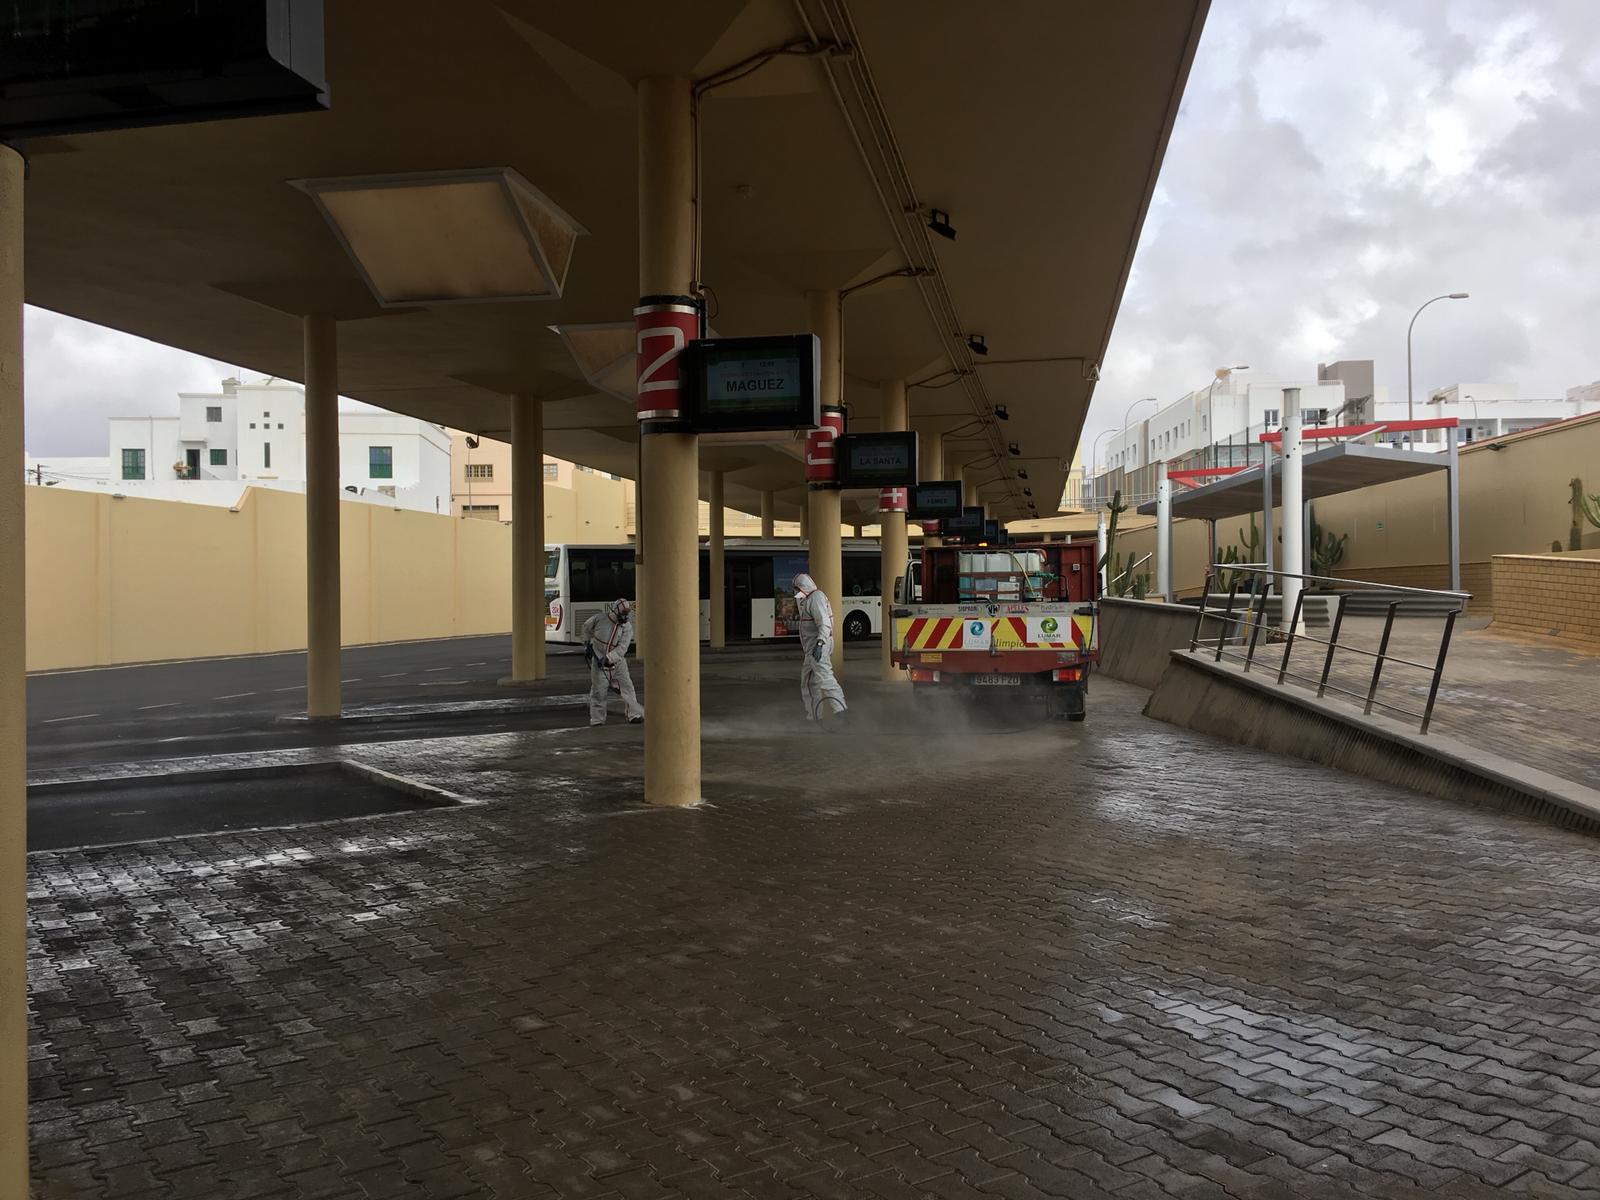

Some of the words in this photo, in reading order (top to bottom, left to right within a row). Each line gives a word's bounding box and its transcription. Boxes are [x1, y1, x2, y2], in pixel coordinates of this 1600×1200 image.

[637, 326, 685, 394] 2
[726, 378, 785, 393] MAGUEZ
[807, 425, 838, 466] 3
